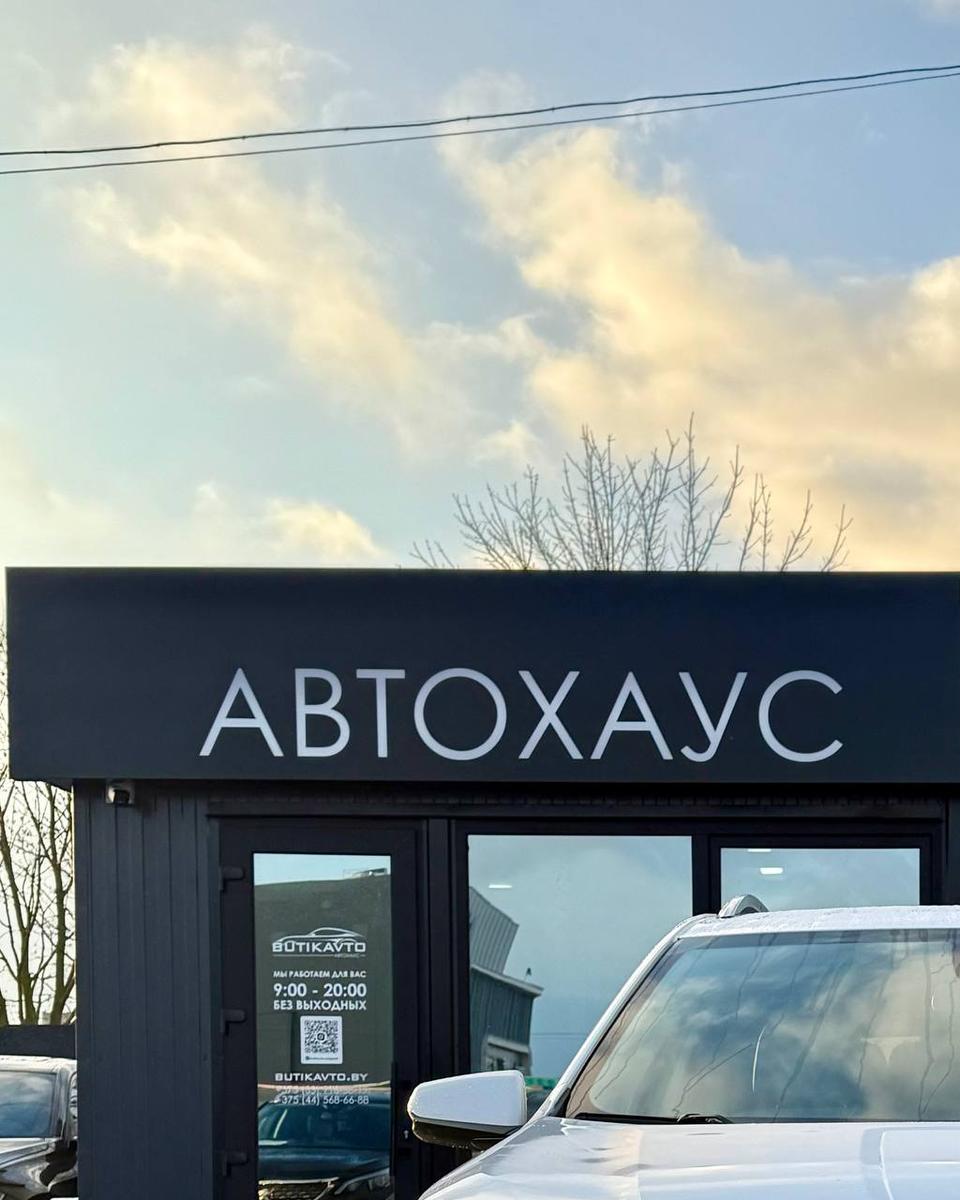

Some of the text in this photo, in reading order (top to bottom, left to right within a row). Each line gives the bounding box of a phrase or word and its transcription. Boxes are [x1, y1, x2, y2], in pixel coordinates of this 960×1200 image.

[200, 667, 844, 764] АВТОХАУС
[272, 941, 366, 953] BUTIKAVTO
[273, 983, 307, 997] 9:00
[323, 983, 367, 997] 20:00
[273, 1000, 367, 1012] БЕЗ ВЫХОДНЫХ
[274, 1073, 369, 1081] BUTIKAVTO.BY
